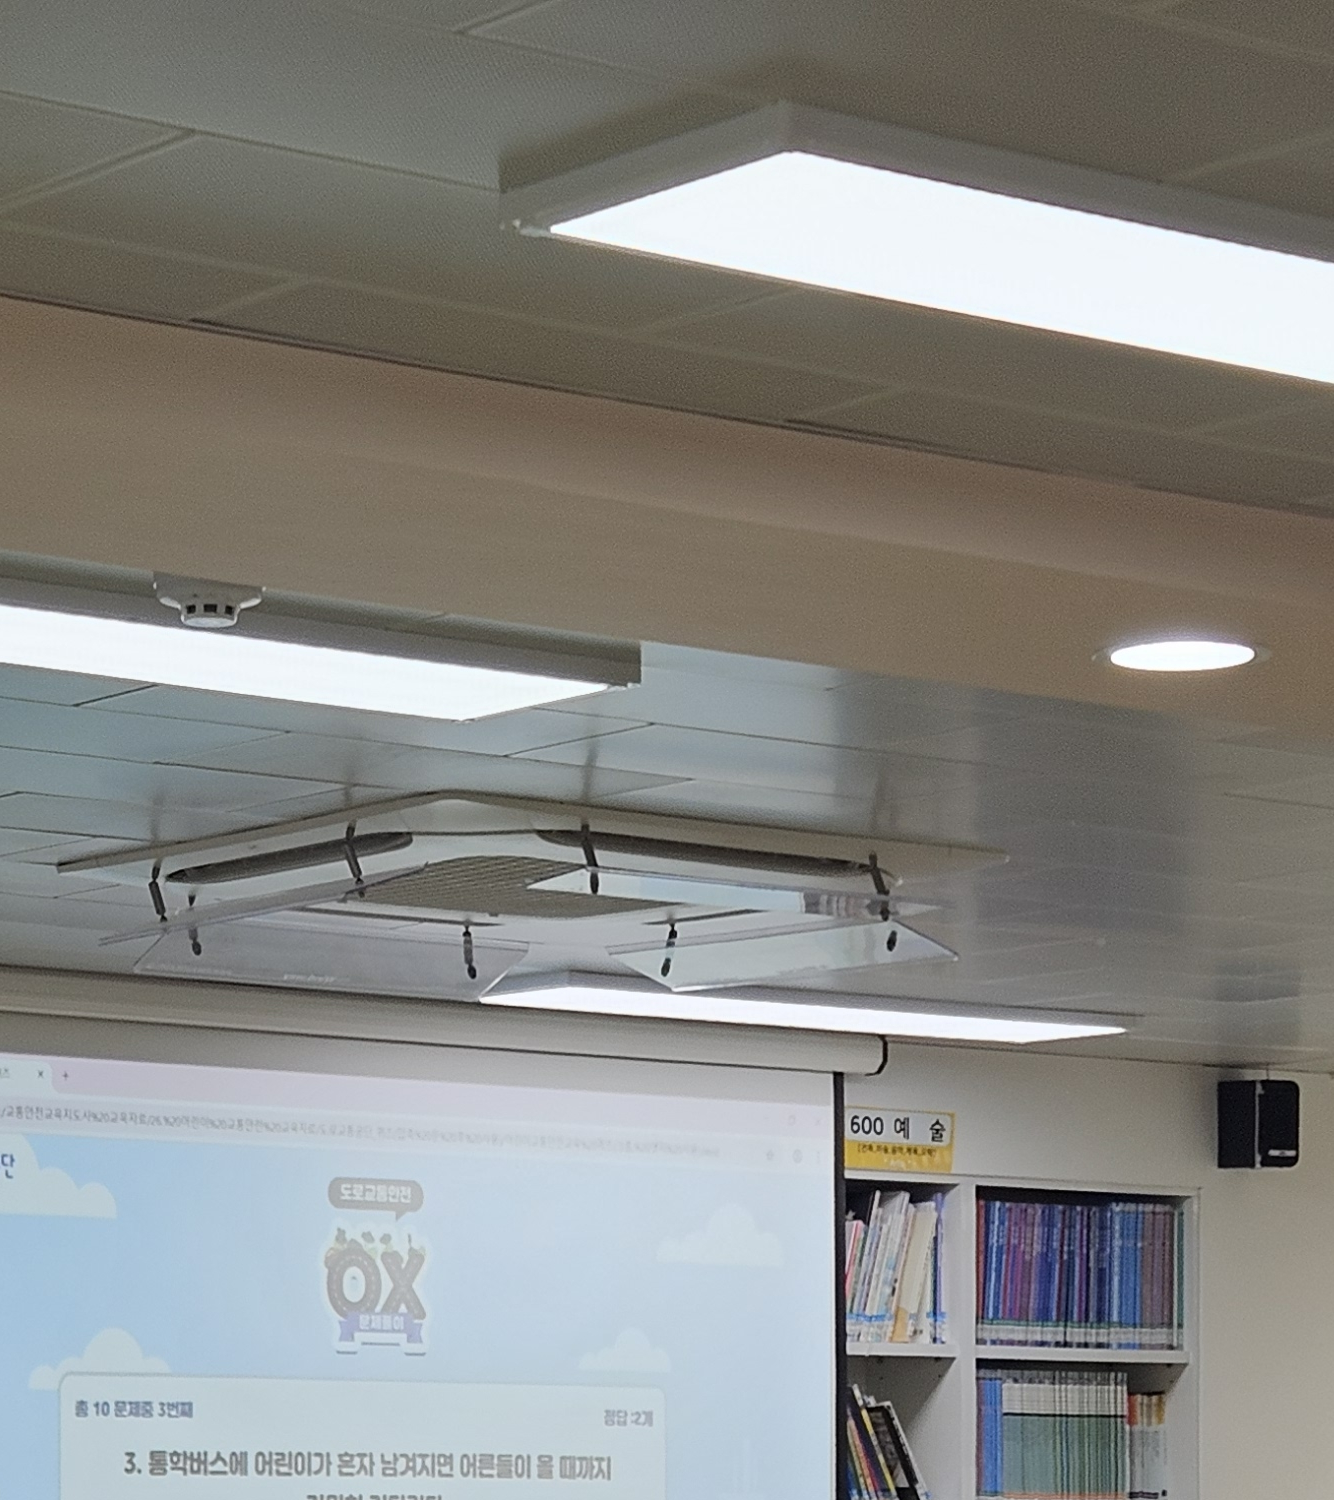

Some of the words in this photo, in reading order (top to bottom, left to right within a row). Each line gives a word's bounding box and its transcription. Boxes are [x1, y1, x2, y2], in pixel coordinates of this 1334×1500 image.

[850, 1115, 884, 1135] 600
[893, 1116, 910, 1140] 예
[928, 1119, 946, 1143] 술
[340, 1184, 412, 1204] 도로교통안전
[325, 1240, 427, 1321] OX
[74, 1400, 89, 1419] 총
[93, 1401, 110, 1418] 10
[157, 1400, 194, 1420] 3번째
[123, 1451, 143, 1476] 3.
[148, 1450, 249, 1478] 통학버스에
[254, 1451, 333, 1478] 어린이가
[336, 1451, 375, 1479] 혼자
[380, 1452, 455, 1480] 남겨지면
[459, 1453, 532, 1480] 어른들이
[559, 1455, 613, 1482] 때까지
